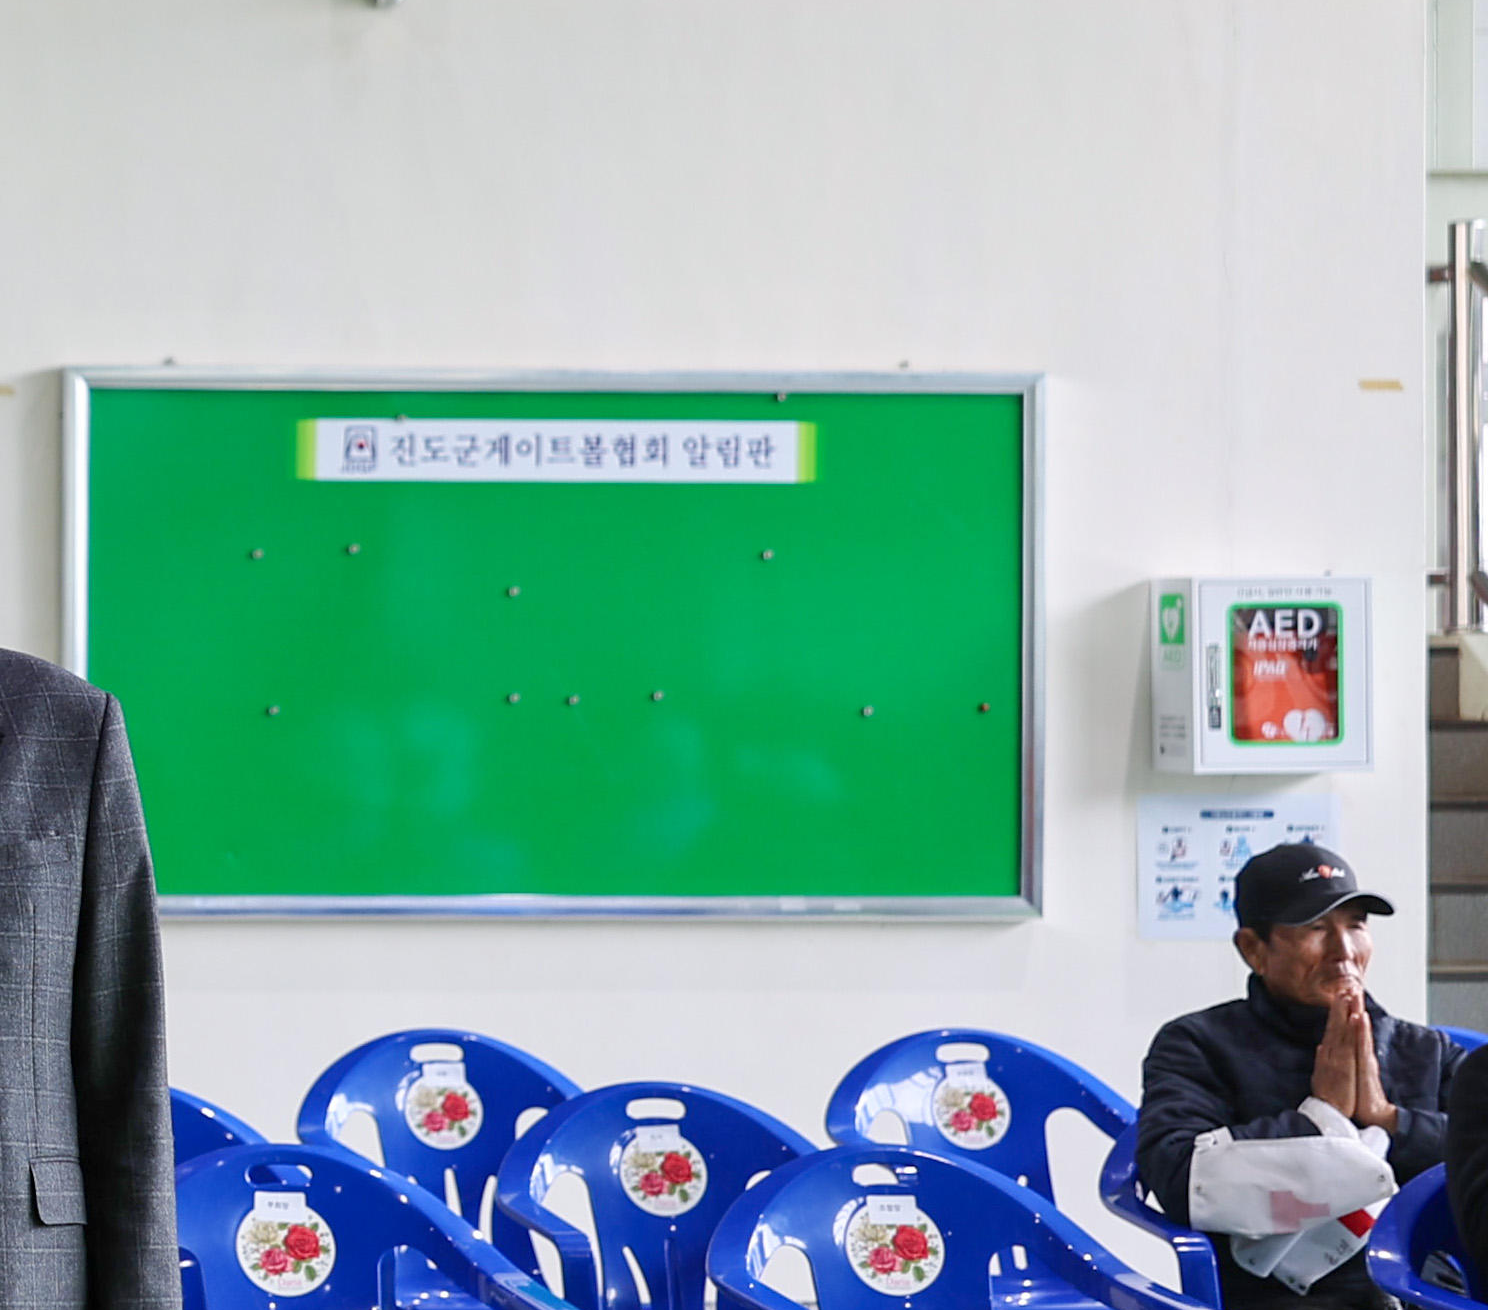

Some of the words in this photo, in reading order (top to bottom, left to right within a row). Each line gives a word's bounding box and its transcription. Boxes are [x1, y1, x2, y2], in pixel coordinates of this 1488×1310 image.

[391, 432, 668, 468] 진도군게이트볼협회
[682, 434, 775, 469] 알림판
[1248, 608, 1323, 639] AED
